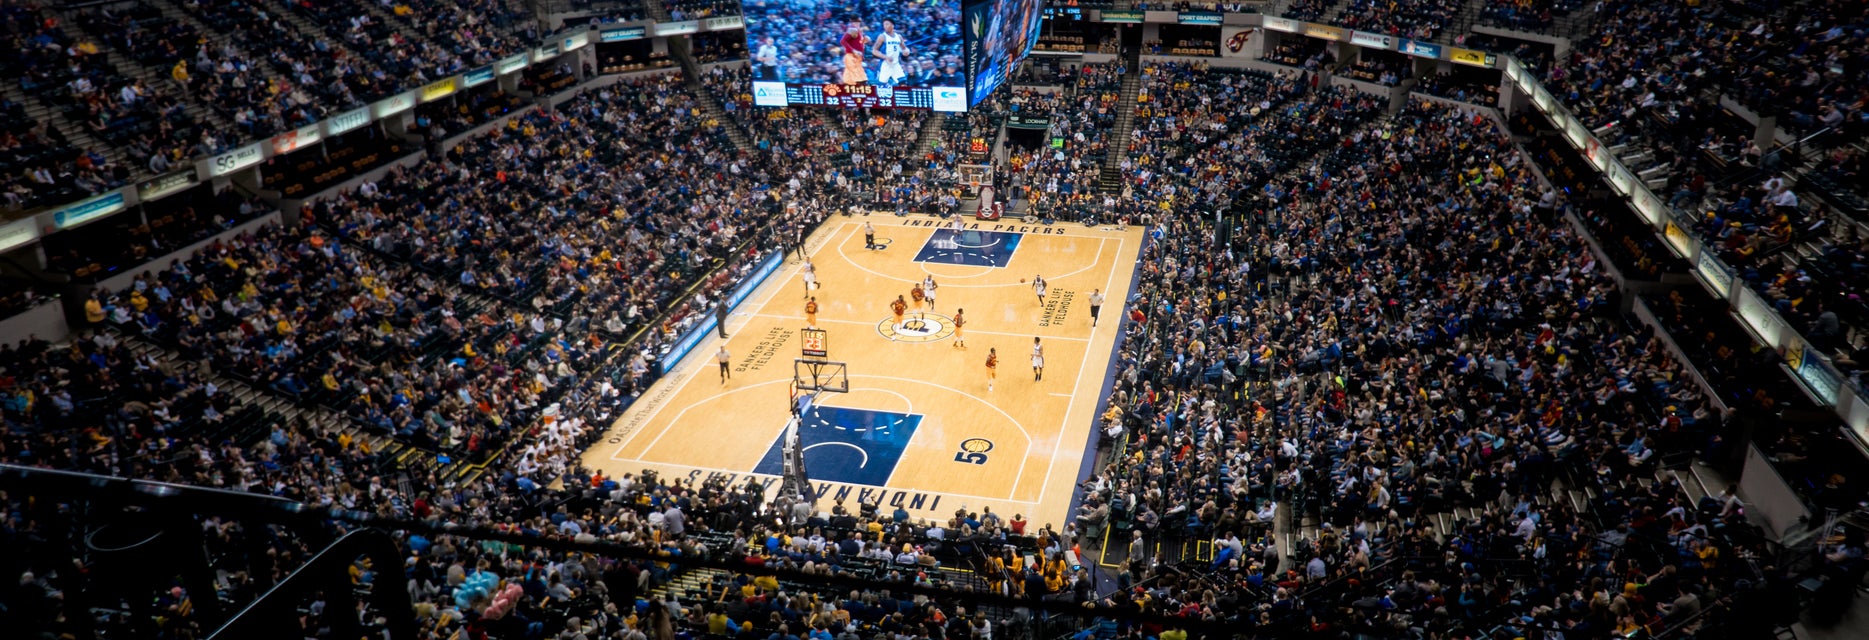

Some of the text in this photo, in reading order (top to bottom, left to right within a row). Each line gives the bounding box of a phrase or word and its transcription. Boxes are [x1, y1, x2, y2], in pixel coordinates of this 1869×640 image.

[619, 28, 645, 37] GRAPHICS
[1485, 56, 1496, 64] CAT
[844, 85, 872, 94] 11:15
[826, 96, 839, 105] 32
[879, 99, 892, 107] 32
[216, 154, 236, 173] SG
[903, 219, 1066, 235] INDIAA PACERS
[1039, 287, 1064, 327] BANKERS LIFE
[1053, 290, 1075, 326] FIELDHOUSE
[735, 341, 770, 372] BANKERS
[766, 327, 784, 340] LIFE
[751, 330, 794, 371] FIELDHOUSE
[805, 339, 822, 350] 23
[954, 438, 993, 465] 50
